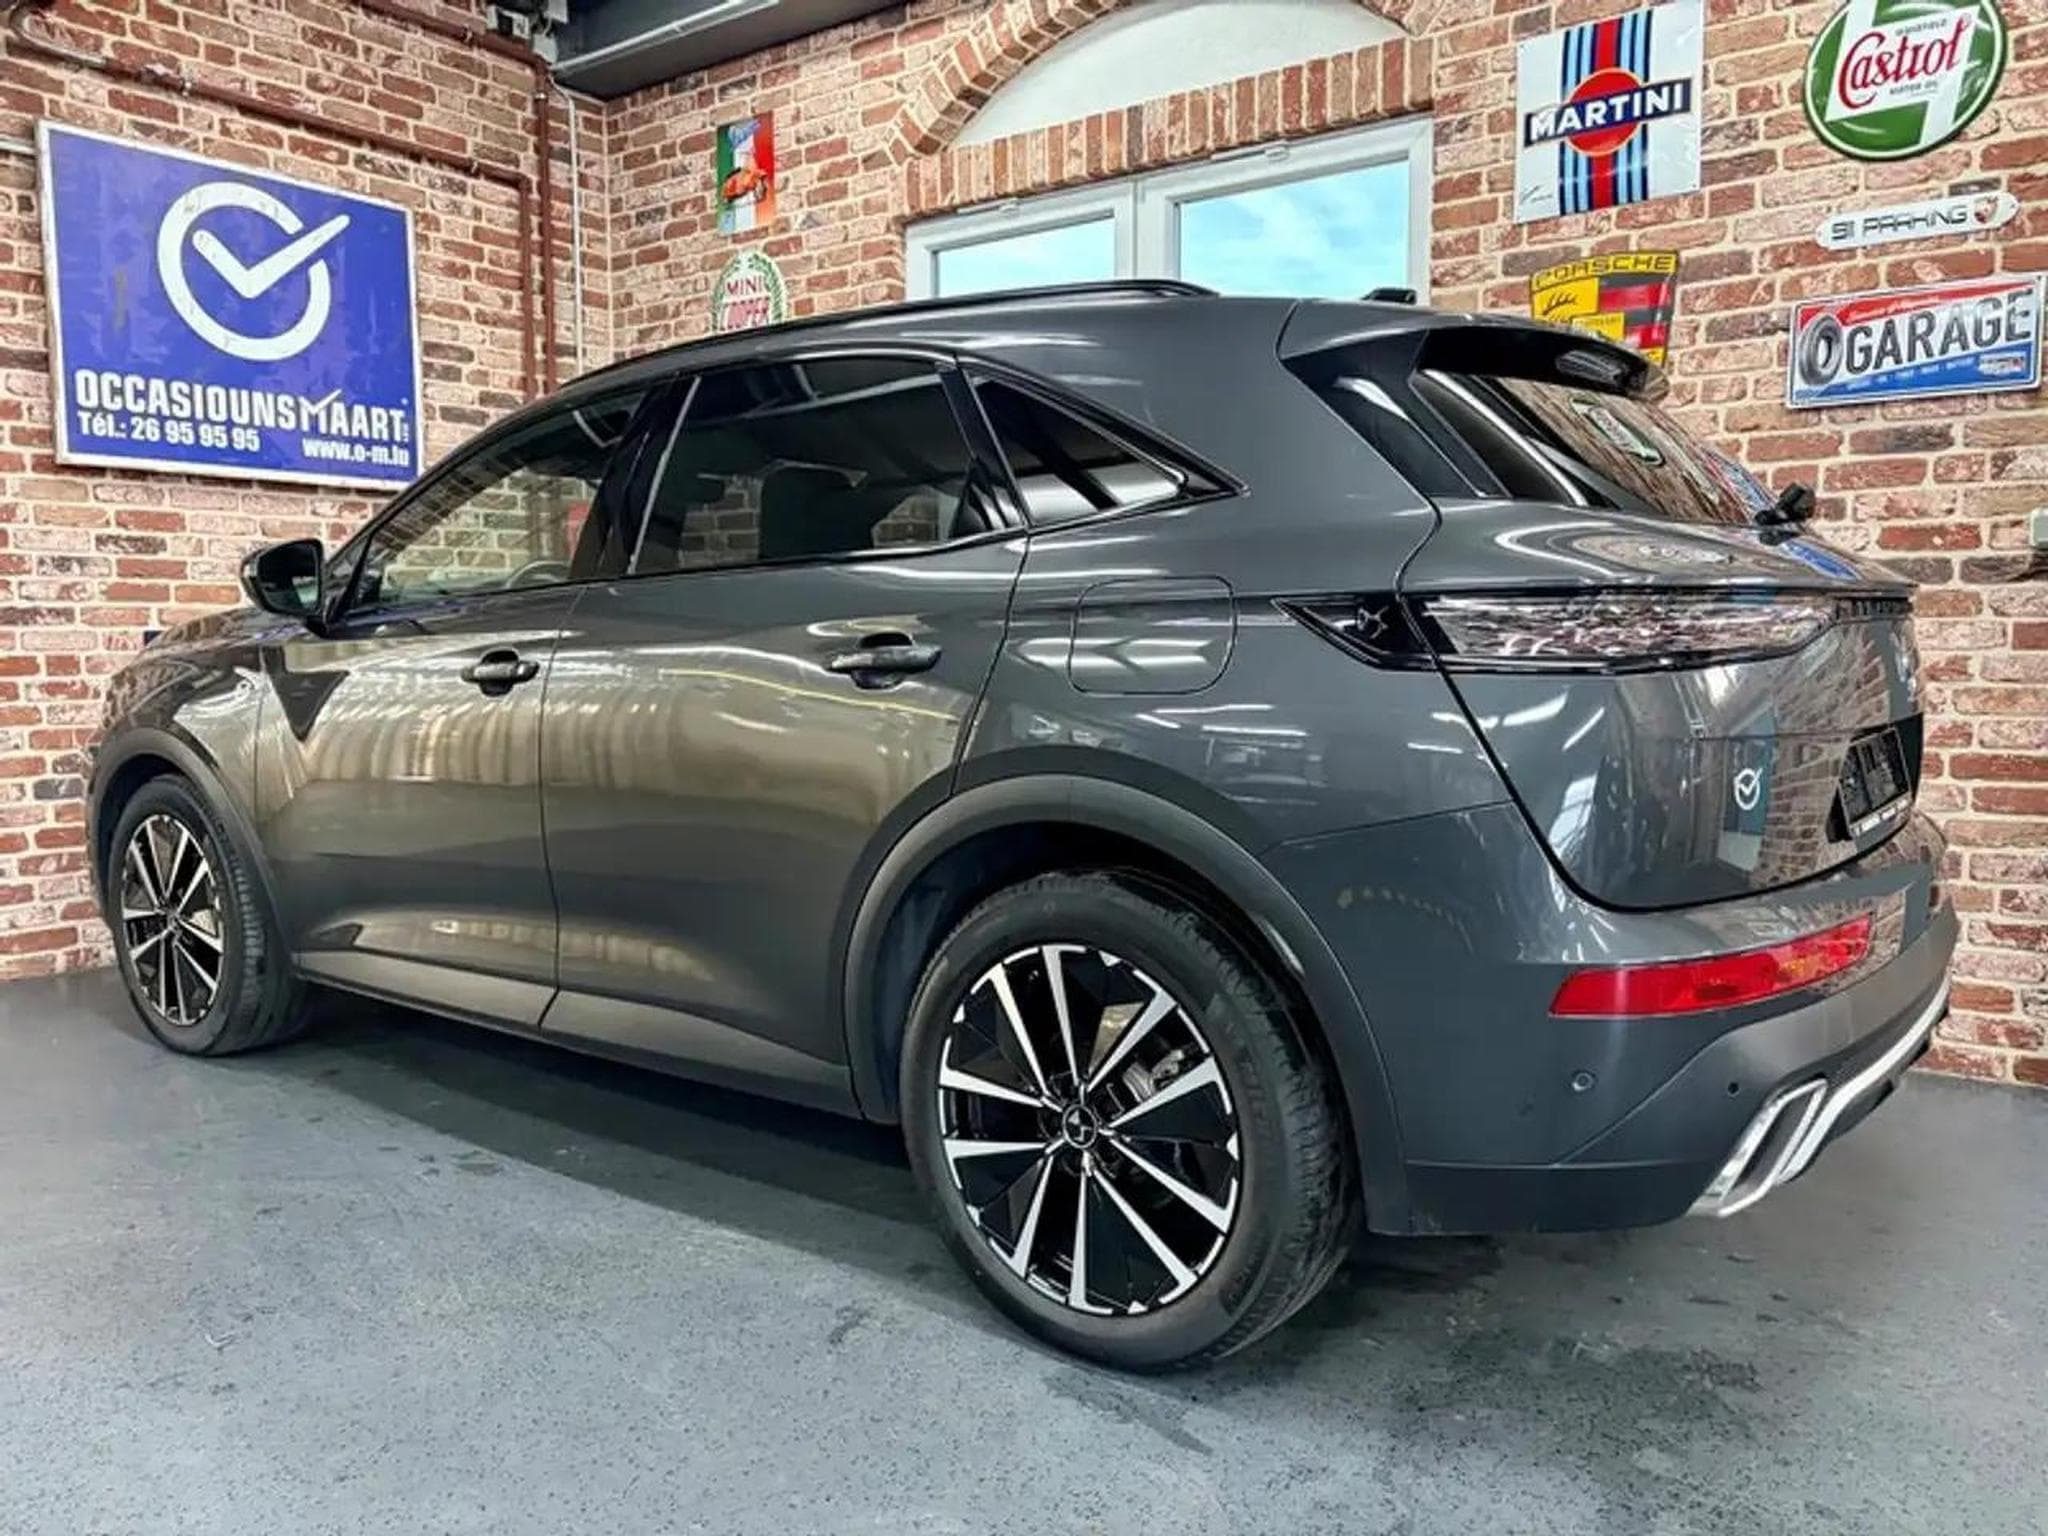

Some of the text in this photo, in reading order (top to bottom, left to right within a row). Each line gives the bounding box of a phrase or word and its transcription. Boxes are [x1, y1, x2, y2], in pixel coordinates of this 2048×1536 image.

[1838, 13, 1971, 109] Castrol
[1530, 83, 1683, 142] MARTINI
[1862, 204, 1967, 237] PARKING
[727, 276, 763, 296] MINI
[1536, 255, 1673, 289] PORSCHE
[1846, 289, 2034, 374] GARAGE
[75, 369, 405, 442] OCCASIOUNSMAART
[77, 410, 260, 452] Tél.: 26 95 95 95
[302, 438, 409, 467] www.o-m.lu
